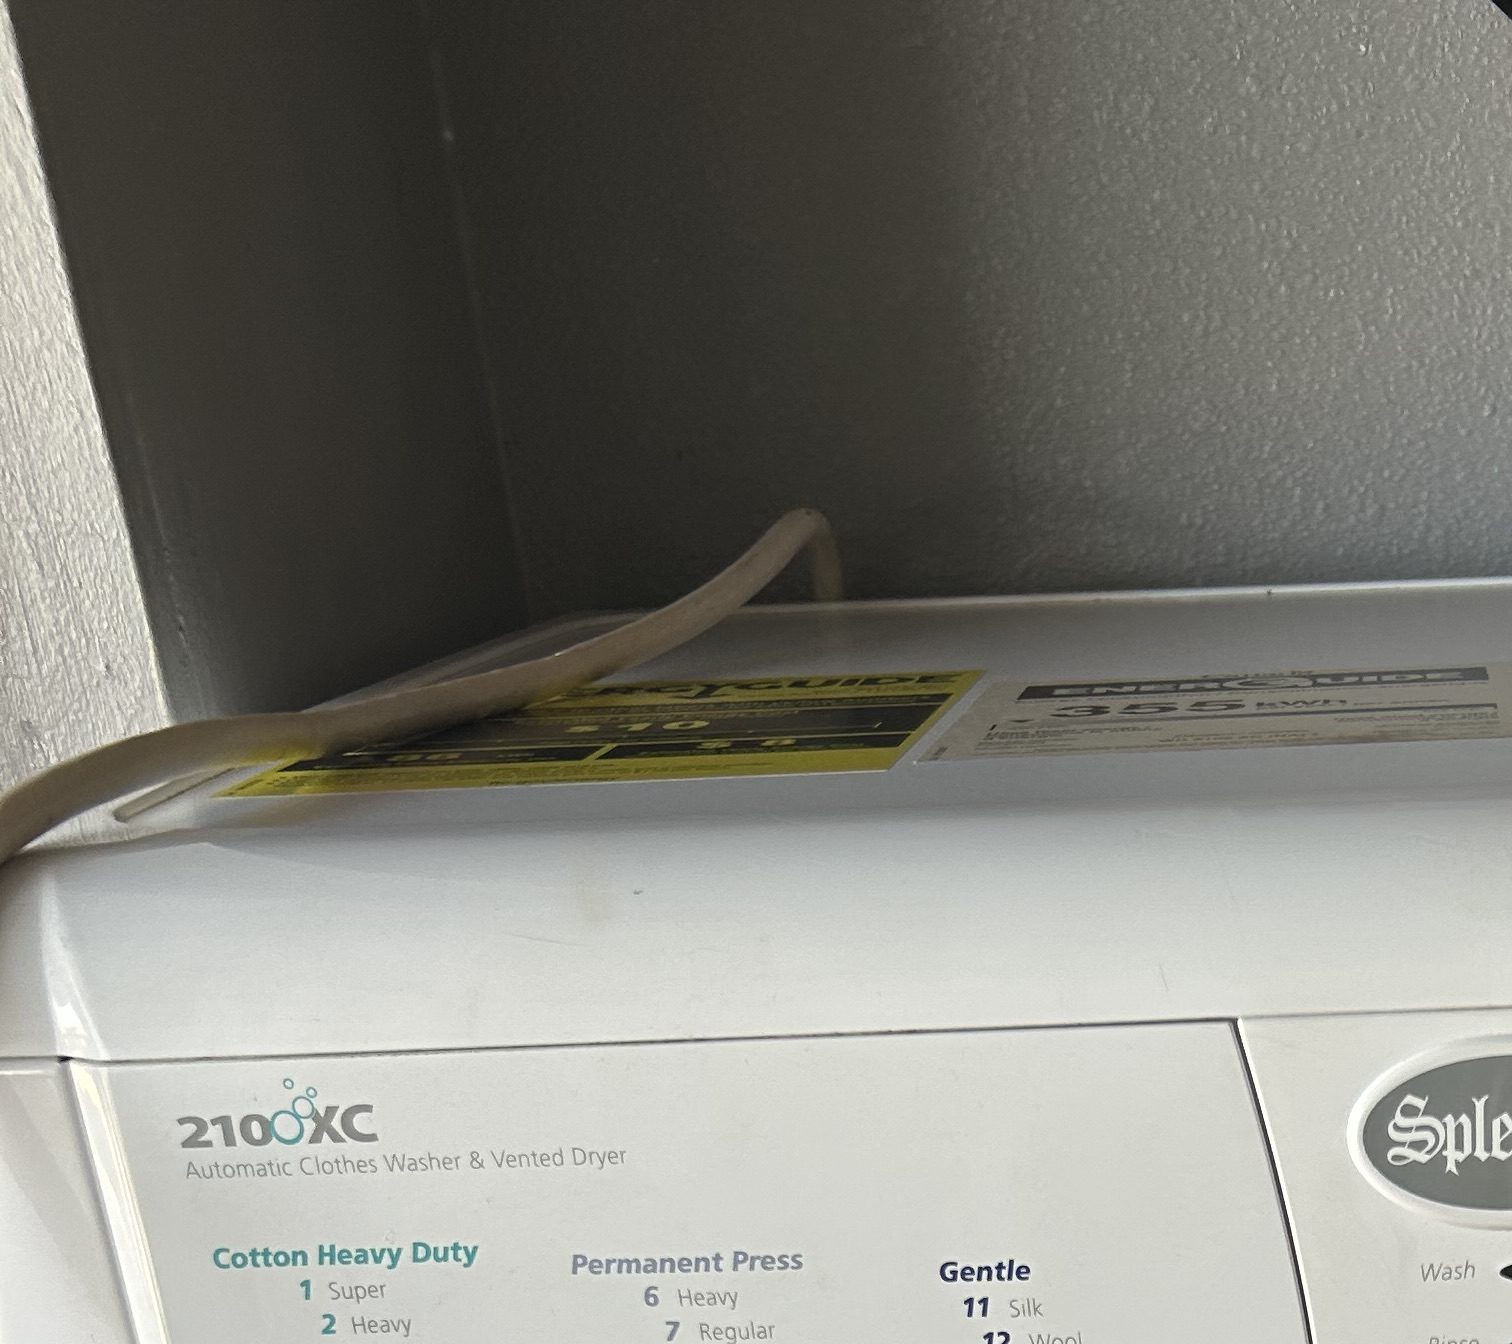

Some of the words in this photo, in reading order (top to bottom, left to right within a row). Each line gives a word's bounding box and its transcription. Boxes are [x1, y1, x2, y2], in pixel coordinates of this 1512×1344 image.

[1049, 699, 1245, 718] 355
[176, 1104, 379, 1149] 2100XC
[185, 1159, 293, 1180] Automatic
[299, 1154, 378, 1176] Clothes
[382, 1151, 461, 1173] Washer
[469, 1150, 485, 1170] &
[490, 1147, 565, 1169] Vented
[571, 1147, 627, 1171] Dryer
[212, 1247, 309, 1270] Cotton
[318, 1243, 403, 1270] Heavy
[412, 1241, 479, 1269] Duty
[571, 1252, 724, 1276] Permanent
[732, 1250, 804, 1272] Press
[939, 1259, 1031, 1283] Gentle
[1420, 1259, 1476, 1283] Wash
[299, 1279, 311, 1301] 1
[328, 1281, 386, 1305] Super
[643, 1285, 660, 1308] 6
[677, 1287, 738, 1311] Heavy
[963, 1296, 989, 1318] 11
[1009, 1297, 1044, 1319] Silk
[321, 1313, 337, 1335] 2
[351, 1315, 412, 1338] Heavy
[665, 1320, 681, 1342] 7
